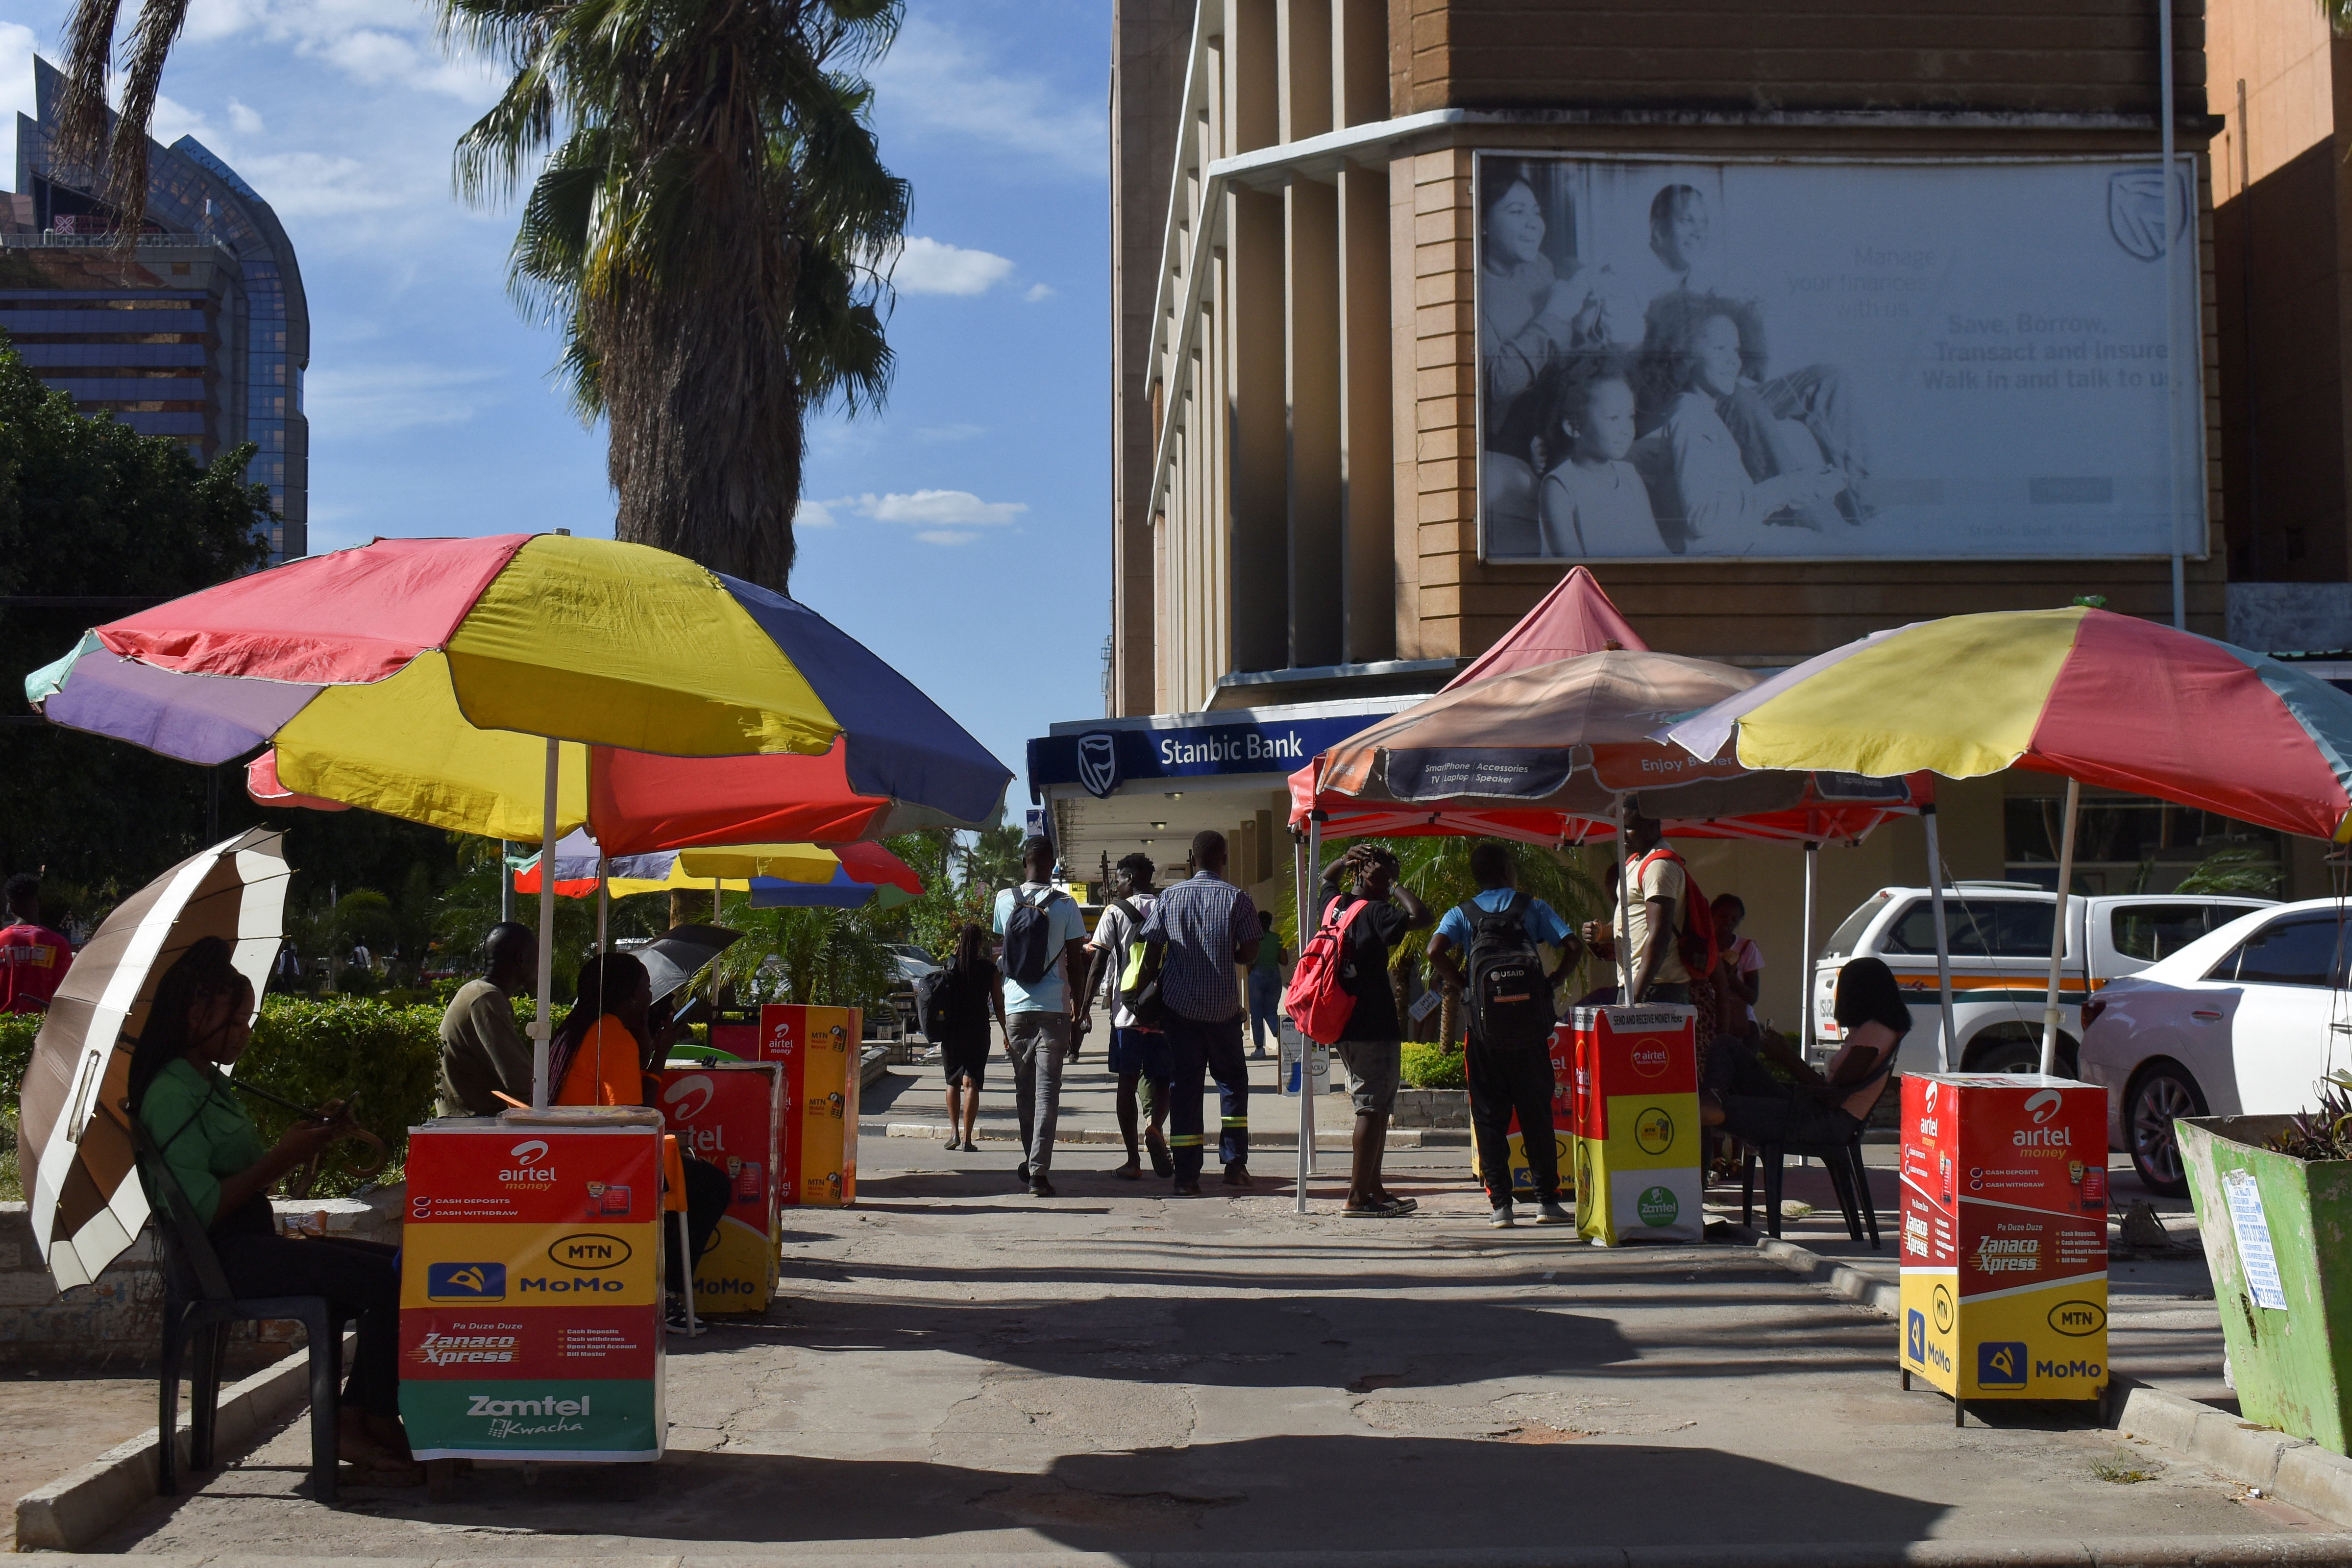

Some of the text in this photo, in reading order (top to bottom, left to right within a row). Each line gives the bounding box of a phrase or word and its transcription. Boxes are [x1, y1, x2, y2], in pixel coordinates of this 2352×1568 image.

[1854, 246, 1936, 270] Manage
[1788, 273, 1928, 296] your finances
[1948, 314, 2107, 335] Save, Borrow,
[1934, 342, 2035, 362] Transact
[2043, 341, 2087, 361] and
[1922, 369, 1978, 390] Walk
[1987, 369, 2008, 388] in
[2015, 369, 2058, 390] and
[2065, 369, 2109, 389] talk
[2118, 368, 2142, 388] to
[1161, 730, 1303, 764] Stanbic Bank
[1425, 762, 1528, 773] SmartPhone Accessories
[1642, 759, 1683, 773] Enjoy
[1431, 773, 1513, 784] TV Laptop Speaker
[1614, 1015, 1625, 1026] SEND
[1626, 1014, 1636, 1025] AND
[1636, 1013, 1654, 1025] RECEIVE
[1654, 1013, 1670, 1024] MONEY
[769, 1039, 793, 1049] airtel
[1642, 1051, 1666, 1060] airtel
[1920, 1116, 1938, 1137] airtel
[1922, 1136, 1936, 1150] money
[2012, 1126, 2072, 1147] airtel
[2020, 1148, 2067, 1160] money
[498, 1167, 557, 1181] airtel
[505, 1182, 552, 1192] money
[1642, 1203, 1676, 1213] Zamtel
[1906, 1210, 1928, 1237] Zanaco
[568, 1245, 612, 1258] MTN
[1906, 1230, 1928, 1258] Xpress
[1977, 1235, 2038, 1253] Zanaco
[1978, 1254, 2037, 1275] Xpress
[520, 1277, 624, 1292] MoMo
[692, 1278, 755, 1295] MoMo
[1936, 1297, 1948, 1321] MTN
[2061, 1312, 2092, 1325] MTN
[420, 1333, 515, 1348] Zanaco
[421, 1348, 514, 1366] Xpress
[1928, 1340, 1951, 1373] MoMo
[2035, 1360, 2102, 1378] MoMo
[467, 1396, 590, 1416] Zamtel
[502, 1417, 585, 1439] Kwacha
